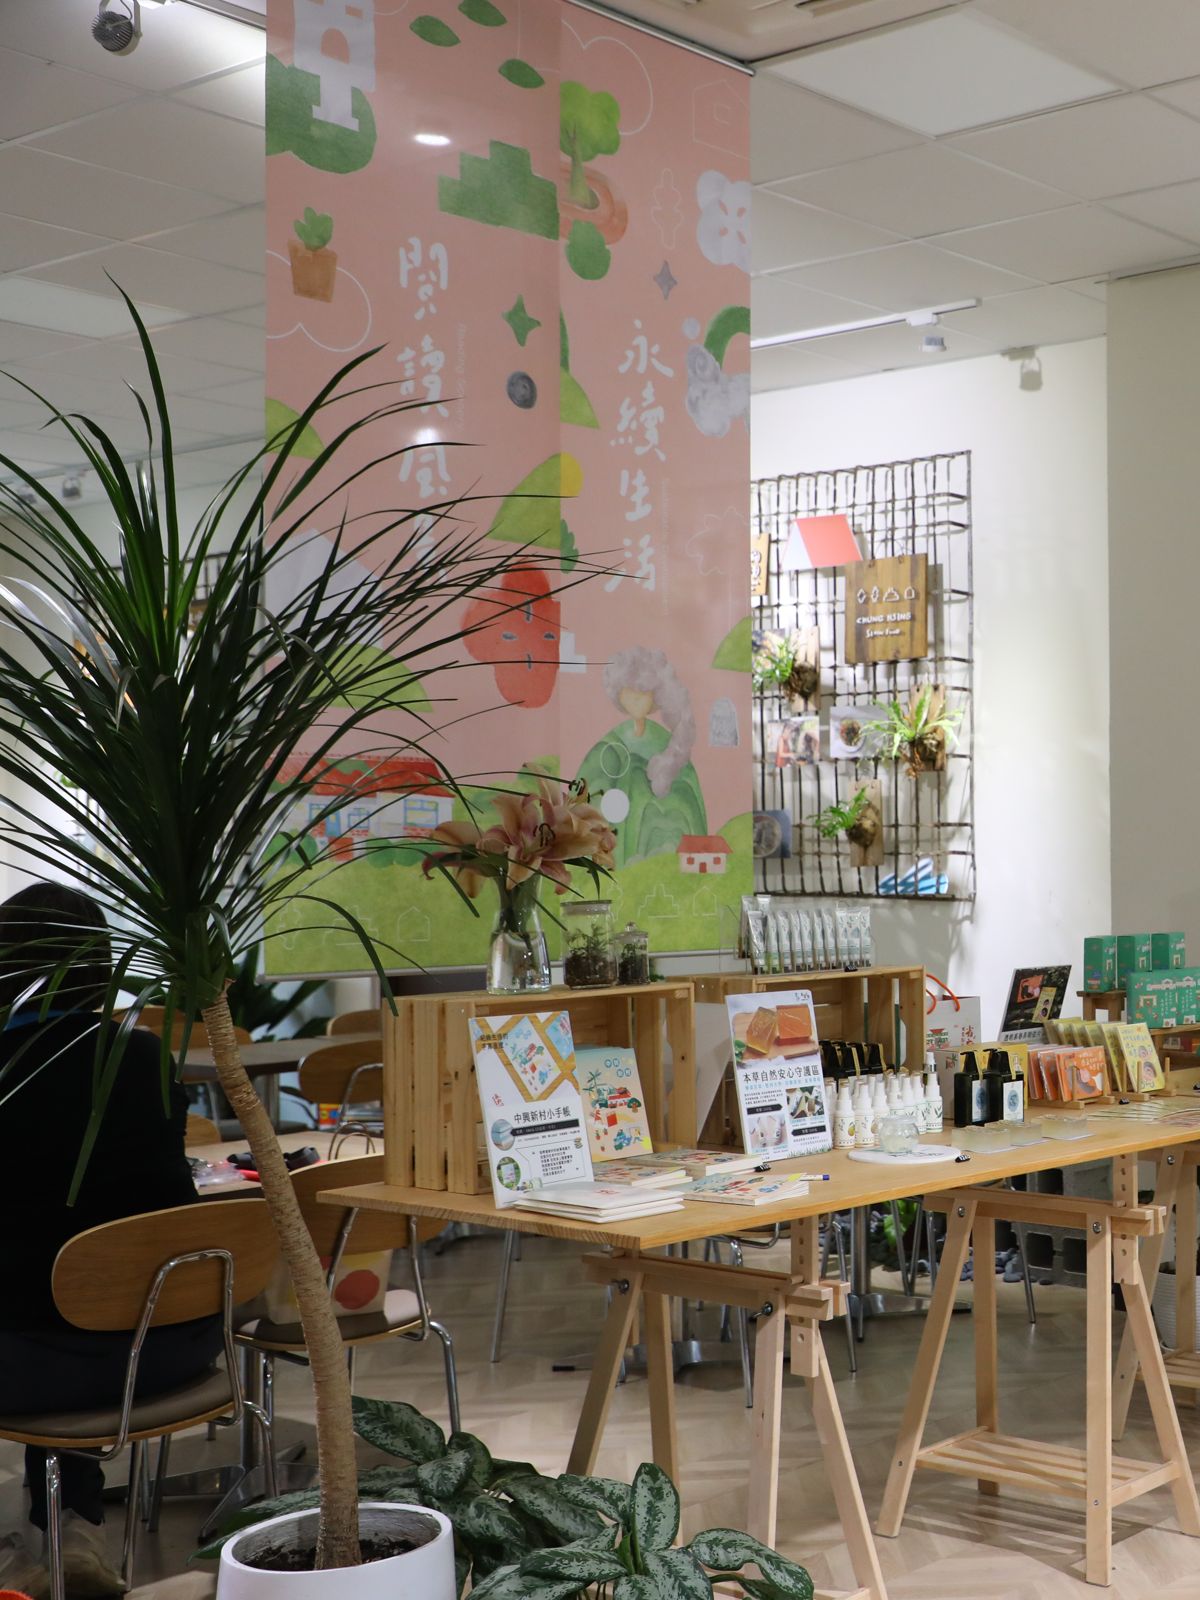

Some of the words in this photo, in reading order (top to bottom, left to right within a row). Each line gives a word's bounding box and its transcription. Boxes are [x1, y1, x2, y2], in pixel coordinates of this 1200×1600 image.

[743, 1065, 820, 1084] 本草自然安心守護區
[513, 1106, 571, 1124] 中興新村小手帳
